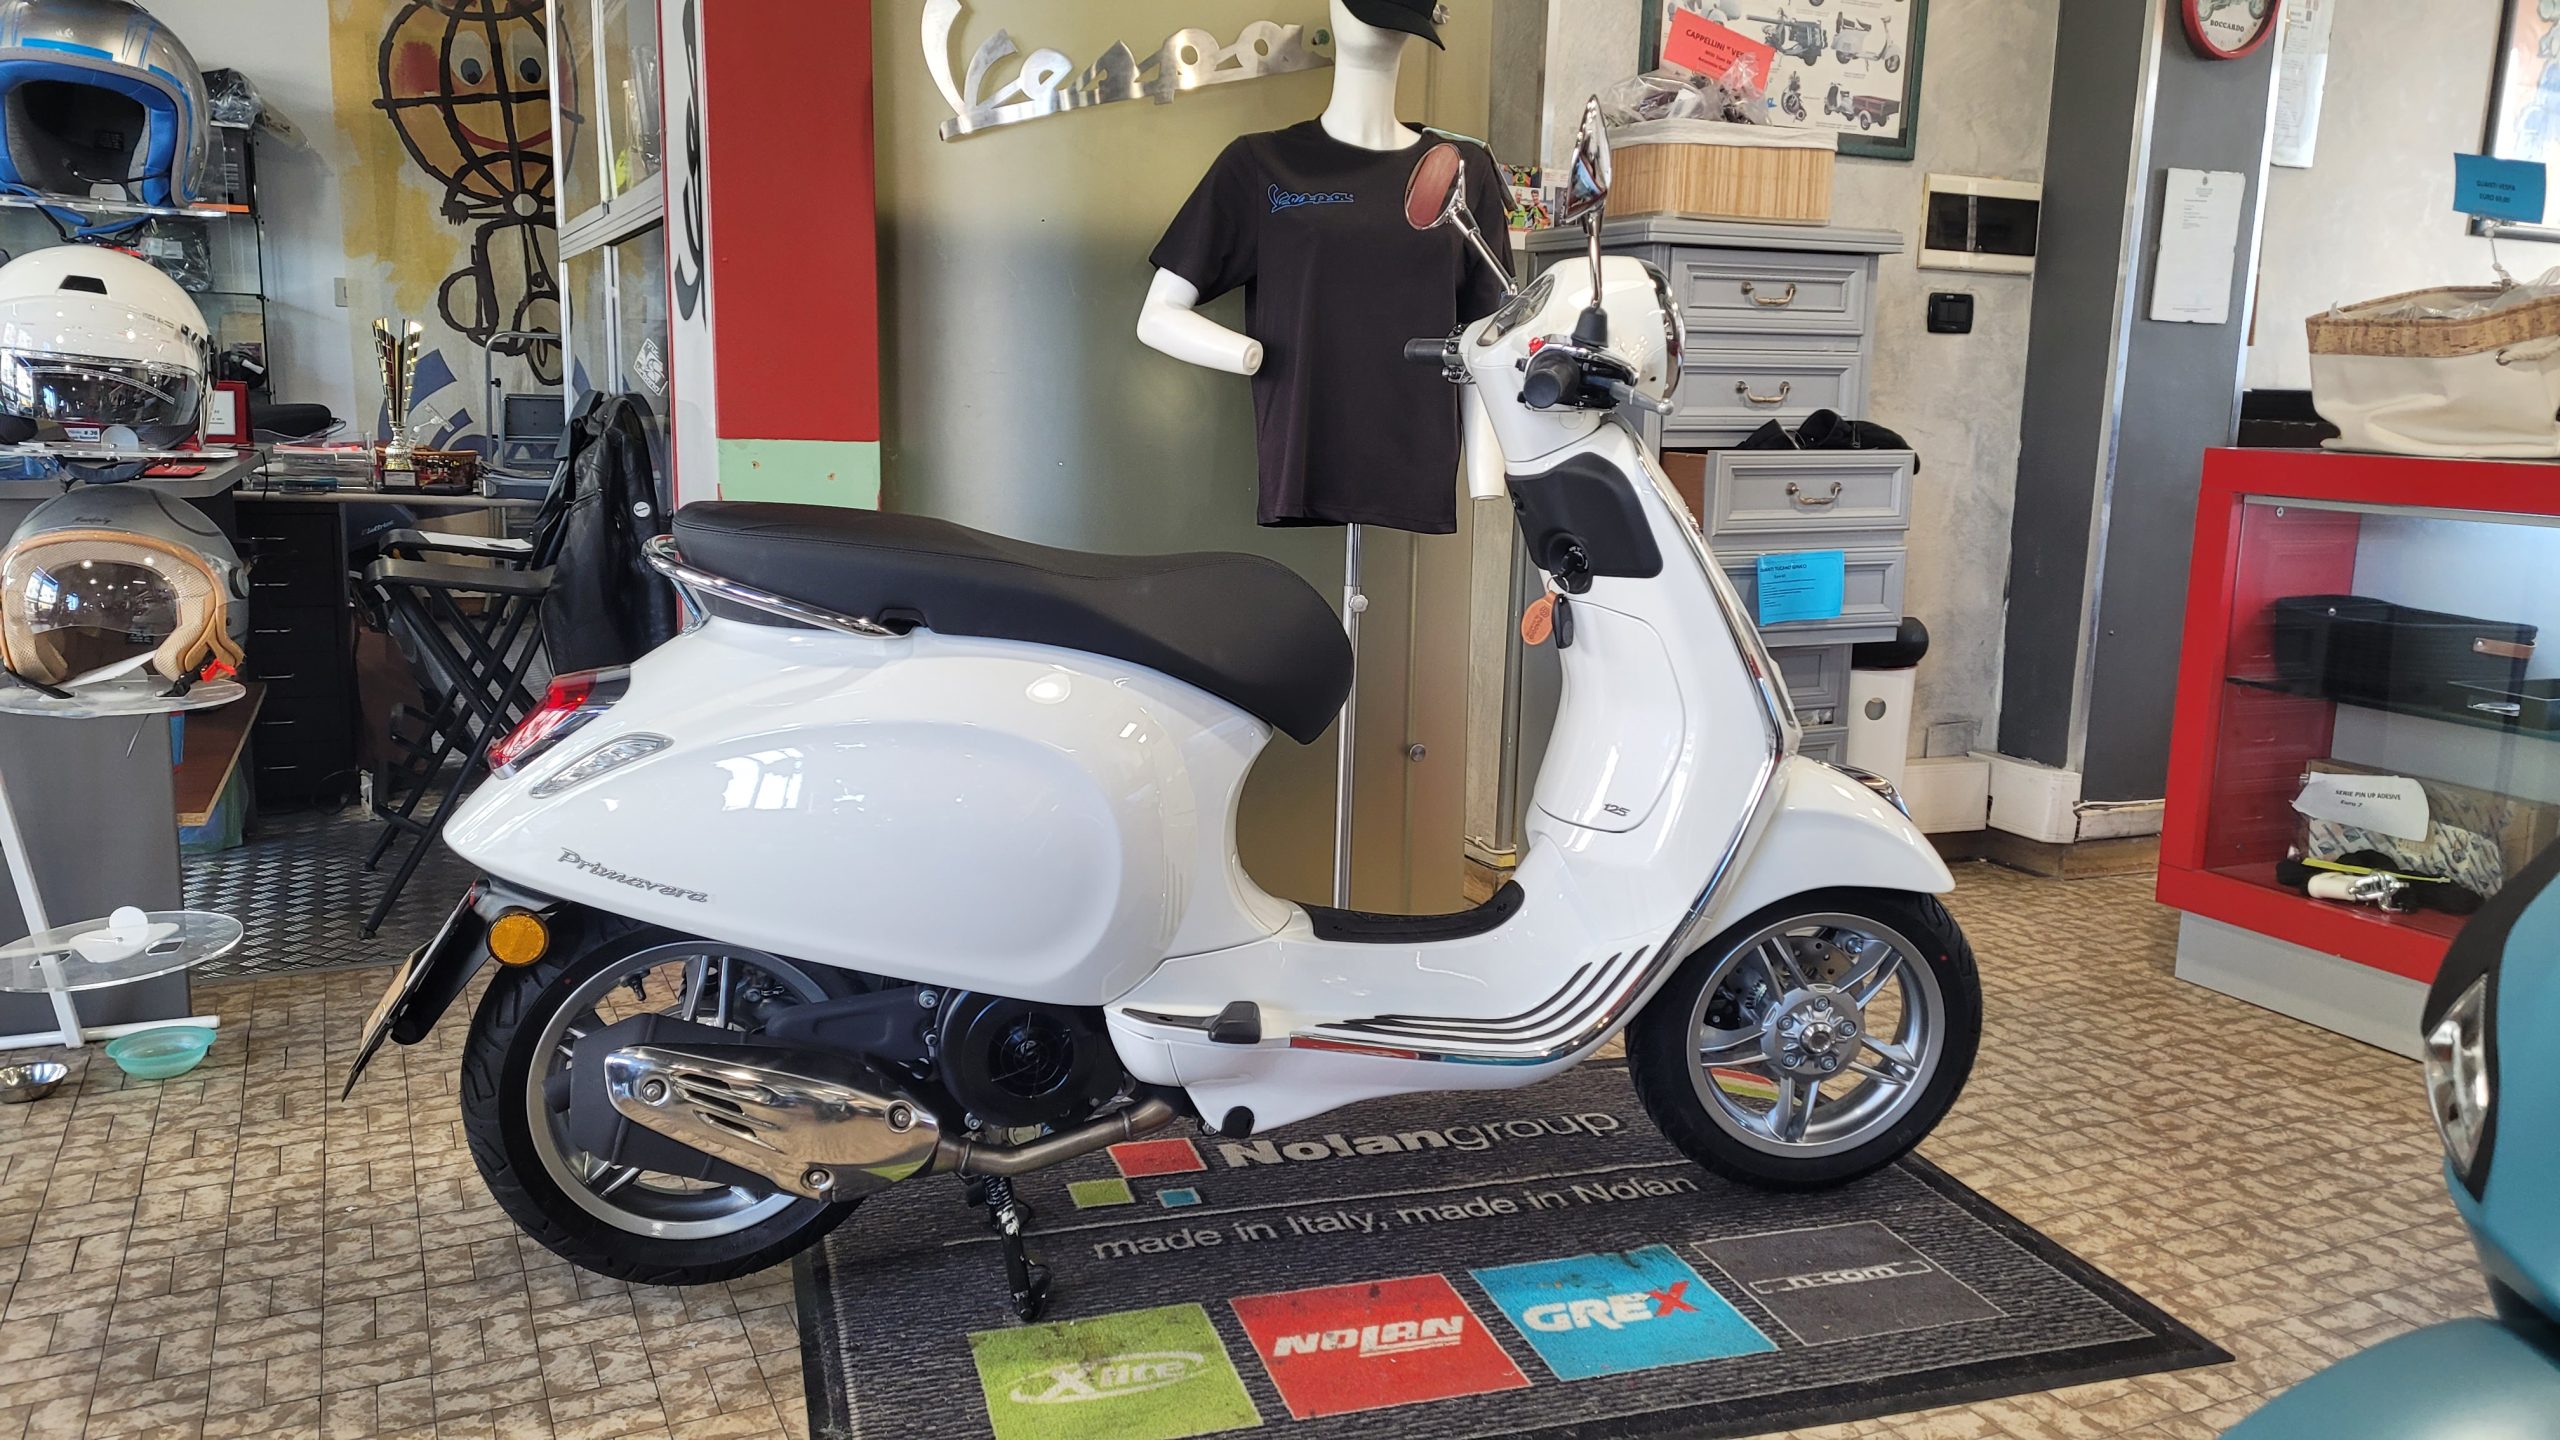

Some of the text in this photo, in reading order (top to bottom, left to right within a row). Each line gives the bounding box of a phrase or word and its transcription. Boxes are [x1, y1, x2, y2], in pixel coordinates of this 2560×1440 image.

[1686, 28, 1726, 52] CAPPELLINI
[2210, 19, 2245, 32] BOCCARDO
[921, 0, 1335, 142] Vespa
[1267, 183, 1355, 213] Vespa
[1603, 803, 1631, 817] 125
[2335, 789, 2353, 798] SERIE
[2354, 791, 2366, 799] PIN
[557, 846, 708, 903] Primavera
[1218, 1112, 1620, 1168] Nolangroup
[1094, 1176, 1699, 1260] made in Italy, made in Nolan
[1523, 1280, 1701, 1334] GREX
[1273, 1316, 1463, 1357] NOLAN
